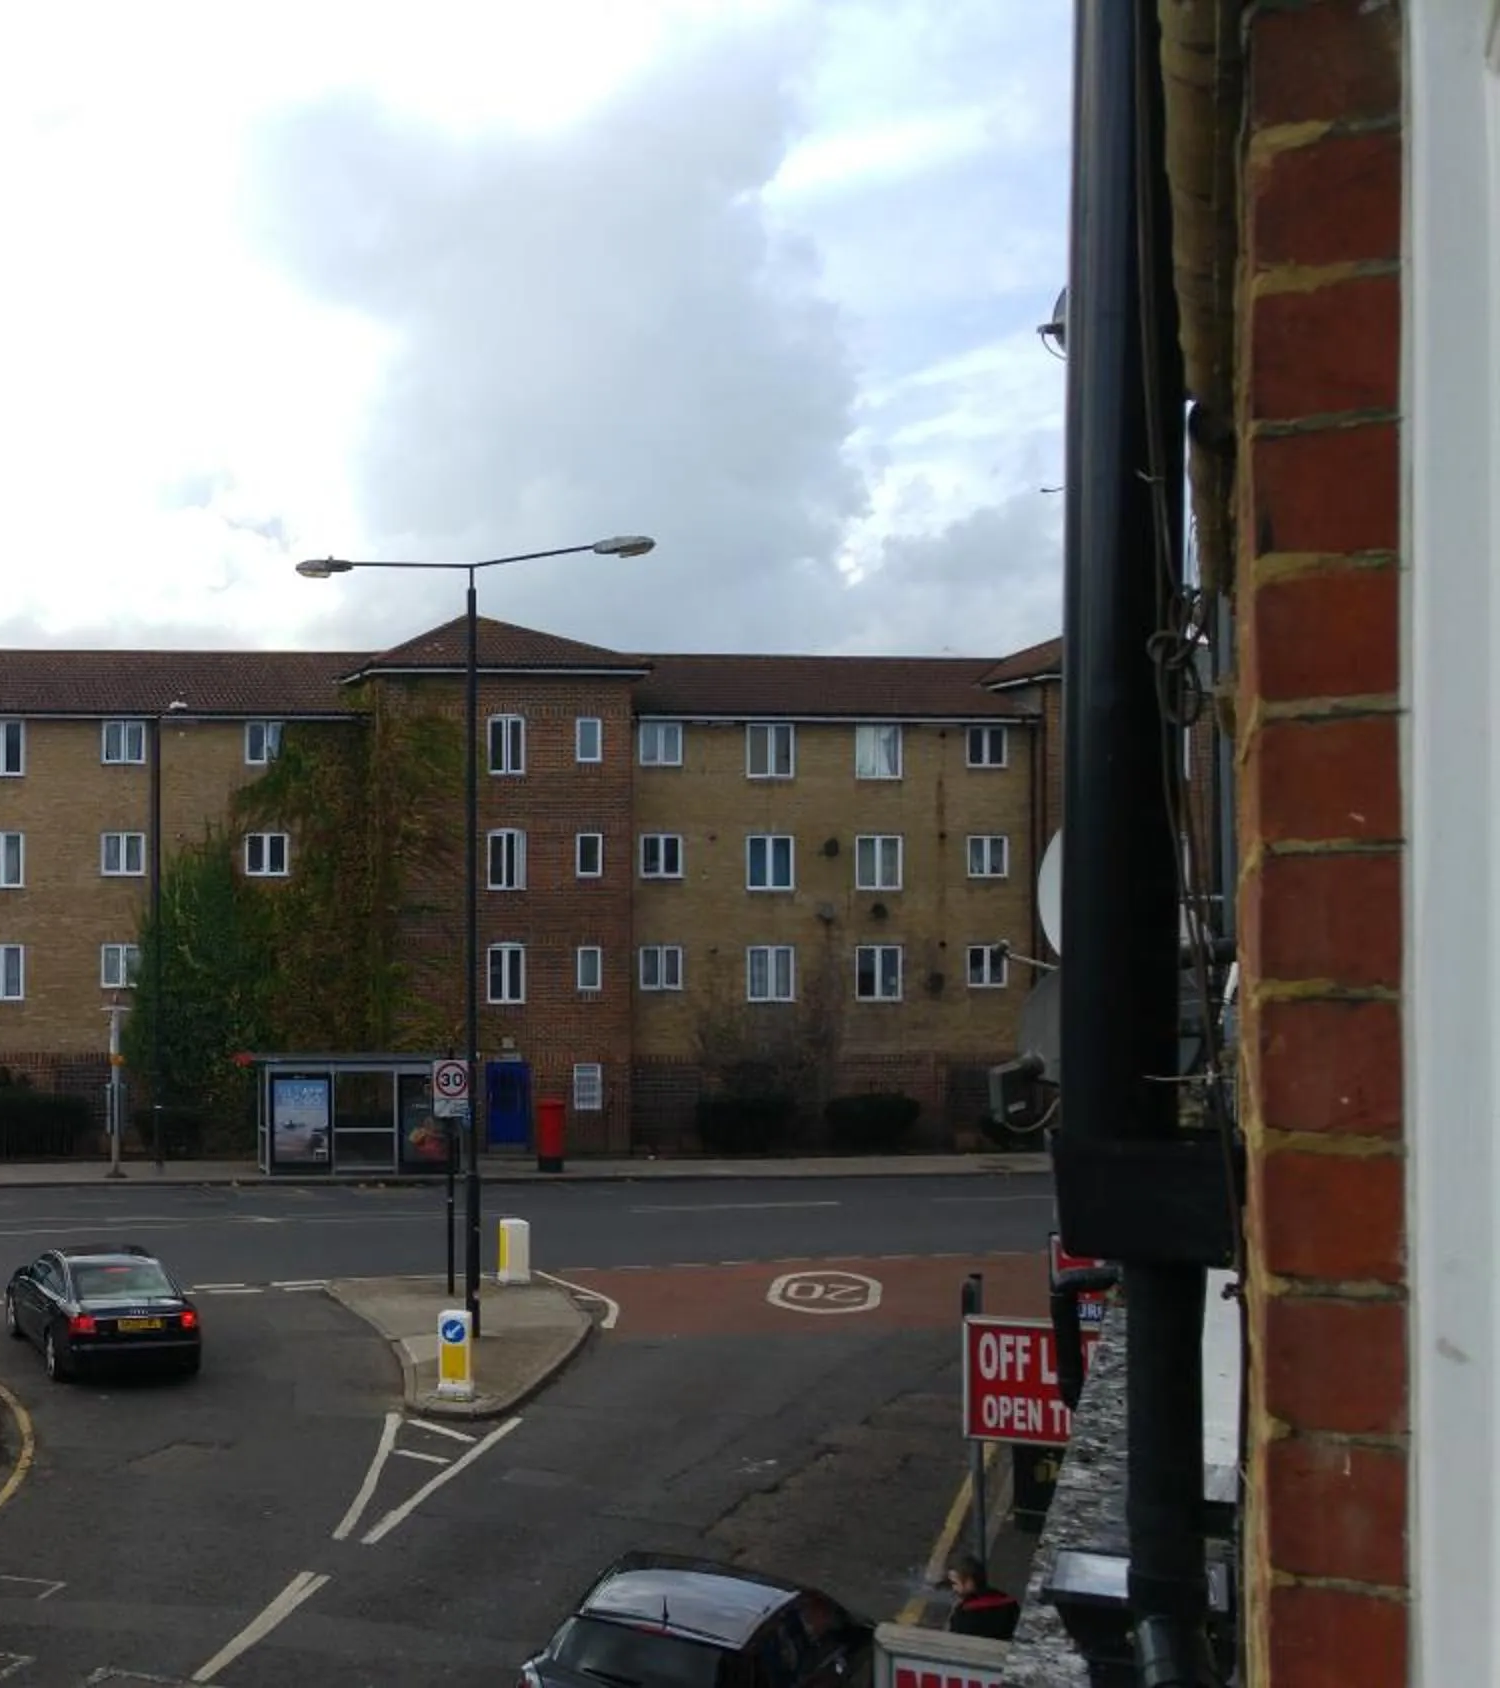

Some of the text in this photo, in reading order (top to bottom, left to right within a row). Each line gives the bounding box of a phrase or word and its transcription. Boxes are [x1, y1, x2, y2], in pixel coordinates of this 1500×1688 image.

[441, 1072, 463, 1087] 30
[979, 1331, 1031, 1382] OFF
[982, 1393, 1073, 1435] OPEN TI
